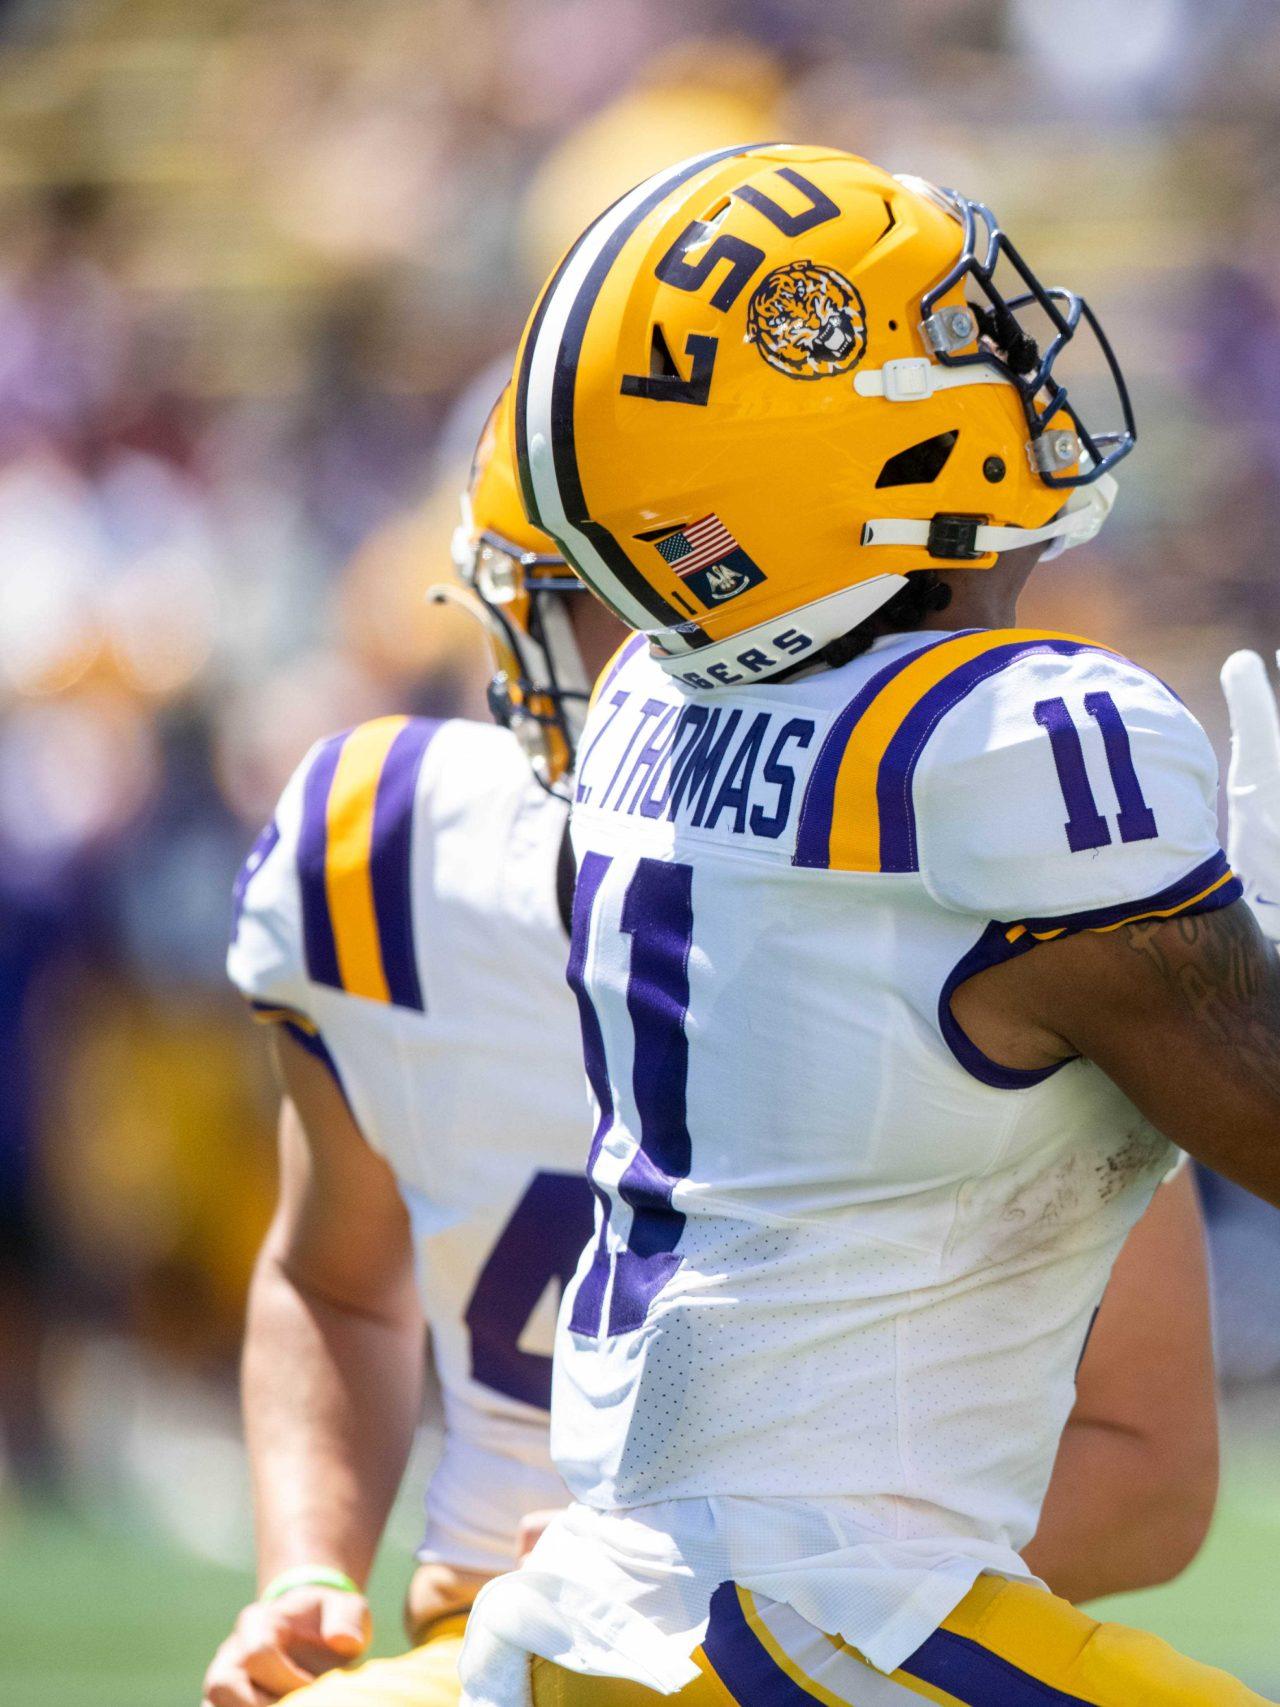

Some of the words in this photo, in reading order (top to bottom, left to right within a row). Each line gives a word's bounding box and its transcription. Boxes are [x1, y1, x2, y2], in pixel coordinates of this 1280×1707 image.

[620, 167, 841, 406] LSU
[600, 698, 815, 839] THOMAS
[1033, 691, 1158, 853] 11
[563, 851, 694, 1337] 11
